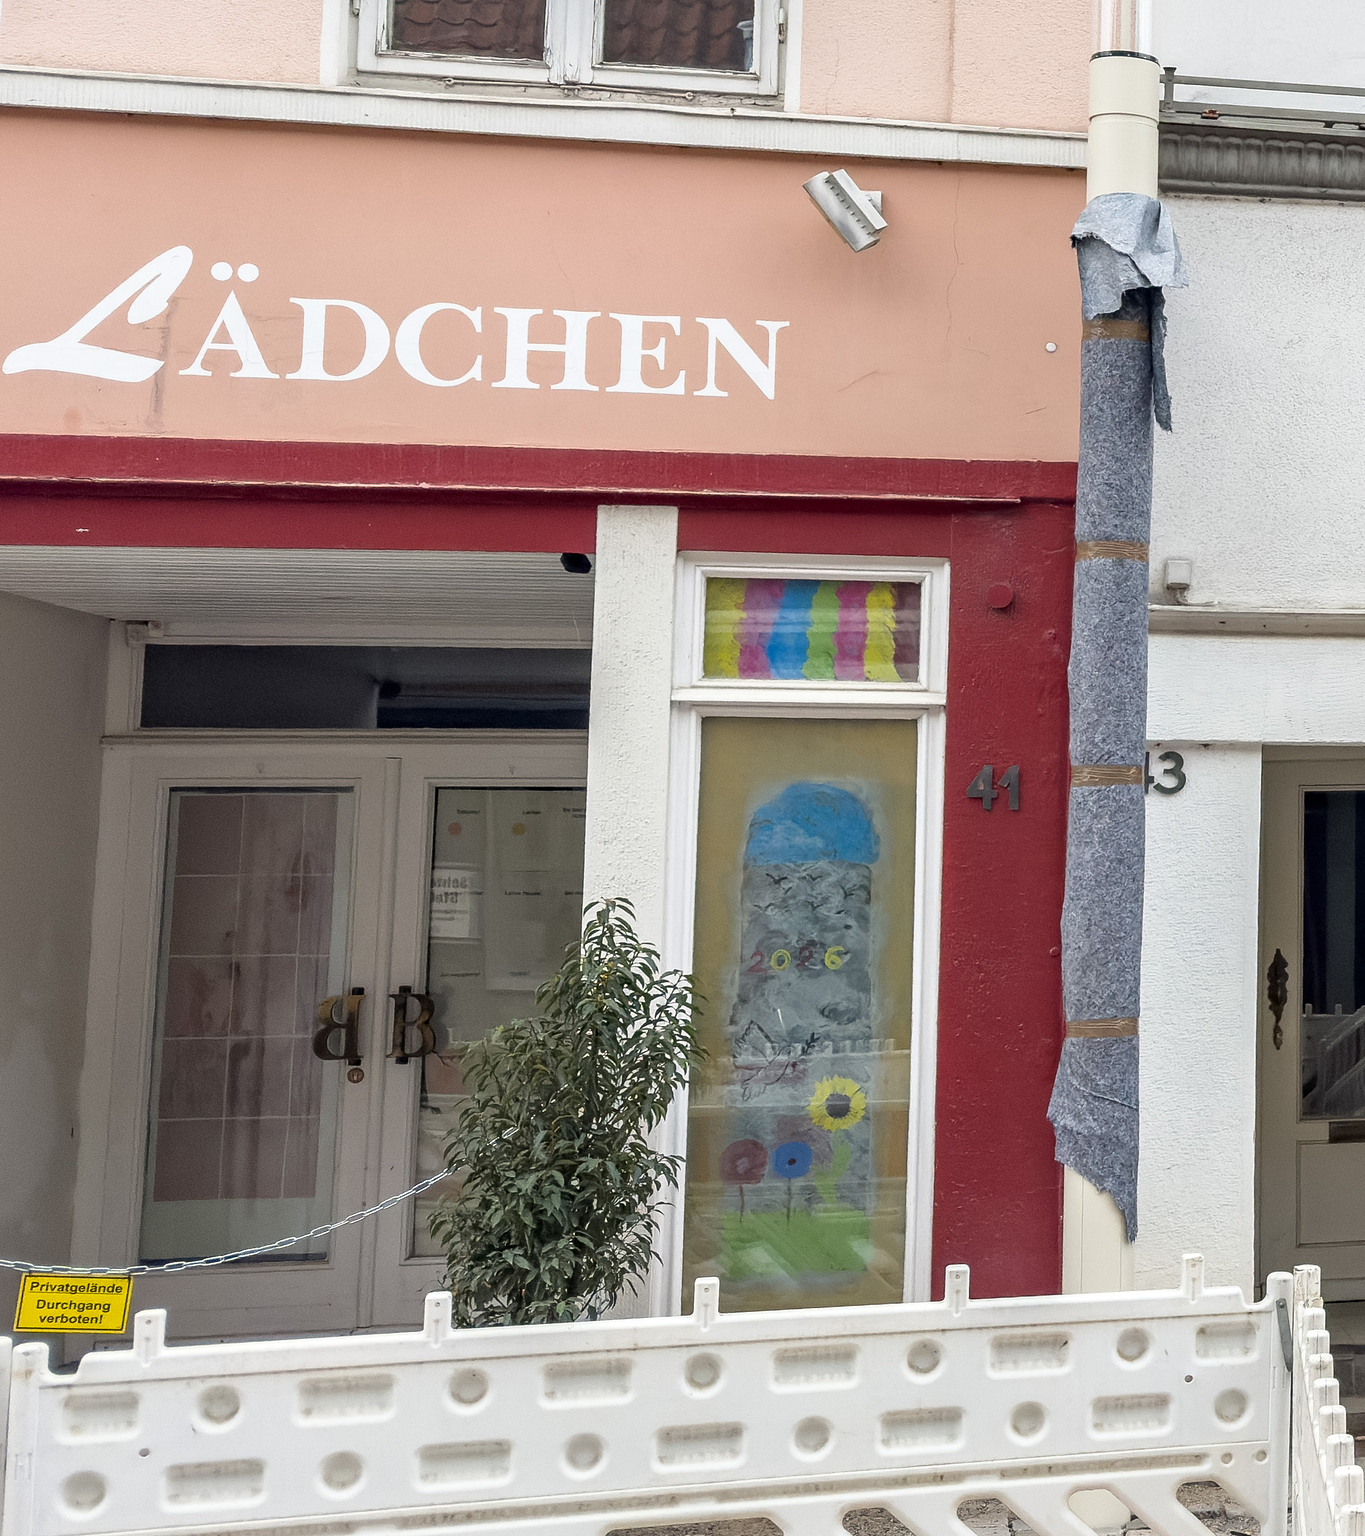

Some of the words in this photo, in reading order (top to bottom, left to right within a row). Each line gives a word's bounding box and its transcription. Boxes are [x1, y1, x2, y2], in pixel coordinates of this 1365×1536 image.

[2, 245, 791, 400] LÄDCHEN
[966, 764, 1020, 812] 41
[747, 945, 845, 975] 2026
[386, 993, 437, 1058] B
[29, 1281, 123, 1295] Privatgelände
[36, 1299, 111, 1313] Durchgang
[39, 1314, 104, 1325] verboten!
